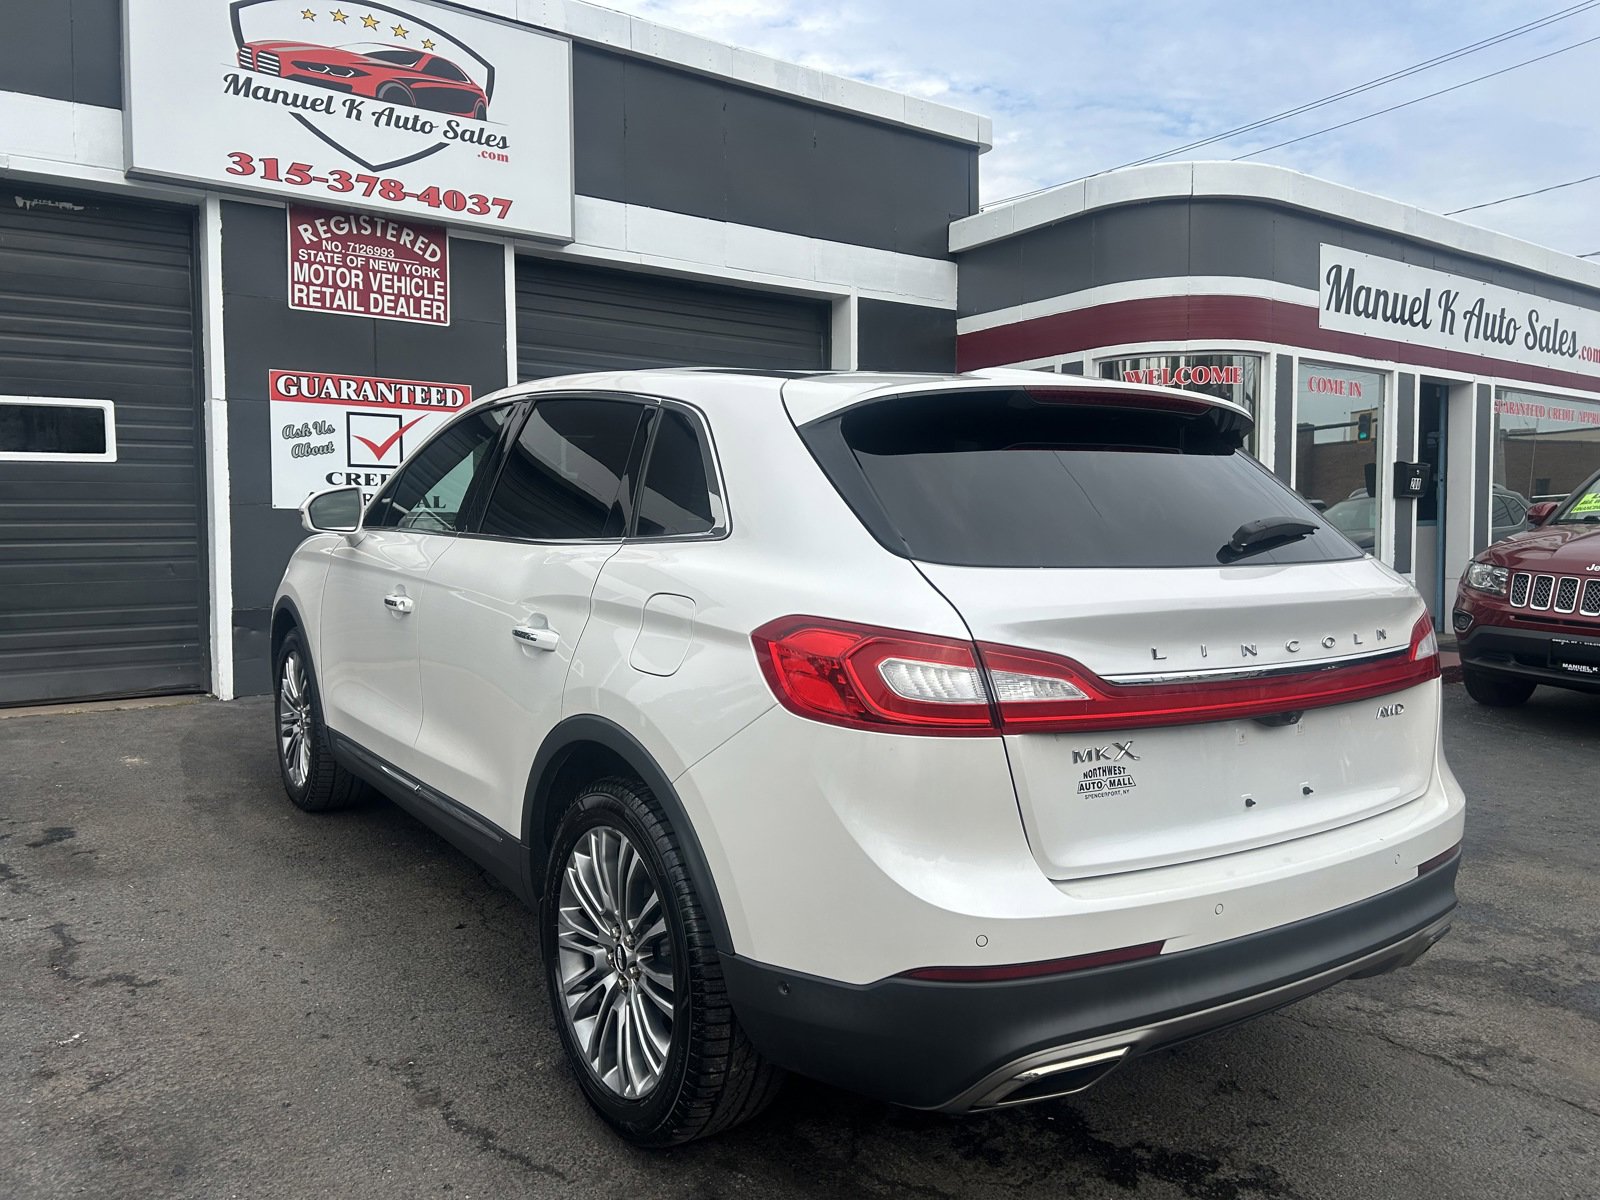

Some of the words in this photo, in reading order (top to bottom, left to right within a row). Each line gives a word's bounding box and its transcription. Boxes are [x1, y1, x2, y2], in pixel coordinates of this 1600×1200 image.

[223, 73, 336, 115] Manuel
[342, 98, 367, 121] K
[371, 107, 439, 135] Auto
[443, 120, 510, 149] Sales
[477, 150, 509, 163] .com
[225, 151, 513, 220] 315-378-4037
[298, 215, 441, 262] REGISTERED
[322, 240, 346, 253] NO.
[347, 242, 395, 258] 7126993
[298, 249, 343, 265] STATE
[346, 255, 366, 268] OF
[369, 259, 400, 272] NEW
[403, 263, 441, 279] YORK
[293, 261, 364, 290] MOTOR
[369, 271, 445, 300] VEHICLE
[294, 284, 365, 311] RETAIL
[369, 293, 445, 321] DEALER
[1326, 264, 1432, 329] Manuel
[1438, 289, 1460, 335] K
[1463, 297, 1521, 345] Auto
[1524, 309, 1579, 358] Sales
[1123, 365, 1244, 386] WELCOME
[1307, 375, 1346, 397] COME
[1348, 380, 1363, 398] IN
[276, 375, 465, 408] GUARANTEED
[1547, 406, 1575, 423] CREDIT
[282, 422, 312, 439] Ask
[312, 420, 336, 435] Us
[291, 441, 335, 458] About
[1151, 628, 1387, 660] LINCOLN
[1072, 741, 1140, 764] MKX
[1083, 766, 1126, 779] NORTHWEST
[1079, 781, 1103, 792] AUTO
[1109, 777, 1133, 788] MALL
